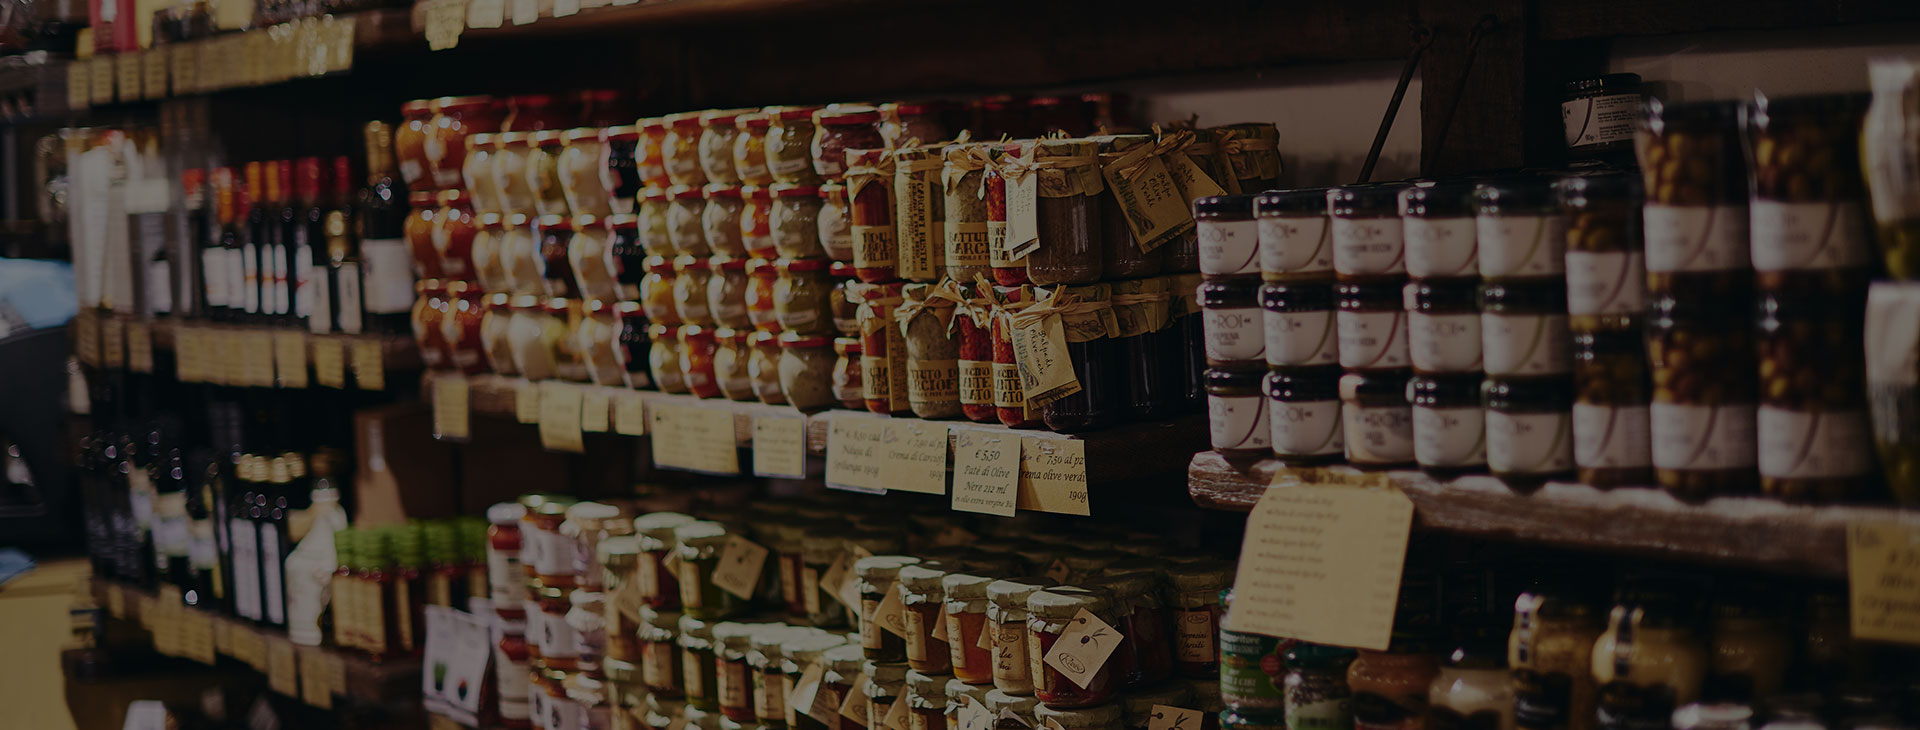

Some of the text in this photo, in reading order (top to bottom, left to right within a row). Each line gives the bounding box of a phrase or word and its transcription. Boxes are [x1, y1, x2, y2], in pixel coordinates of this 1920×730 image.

[981, 450, 1001, 461] 5,50
[1035, 454, 1041, 463] €
[1046, 455, 1063, 466] 7,50
[1072, 456, 1085, 469] pz
[990, 466, 1010, 479] Olive
[1021, 468, 1086, 483] rema olive verdi
[963, 481, 983, 492] Nere
[1068, 490, 1087, 504] 190g
